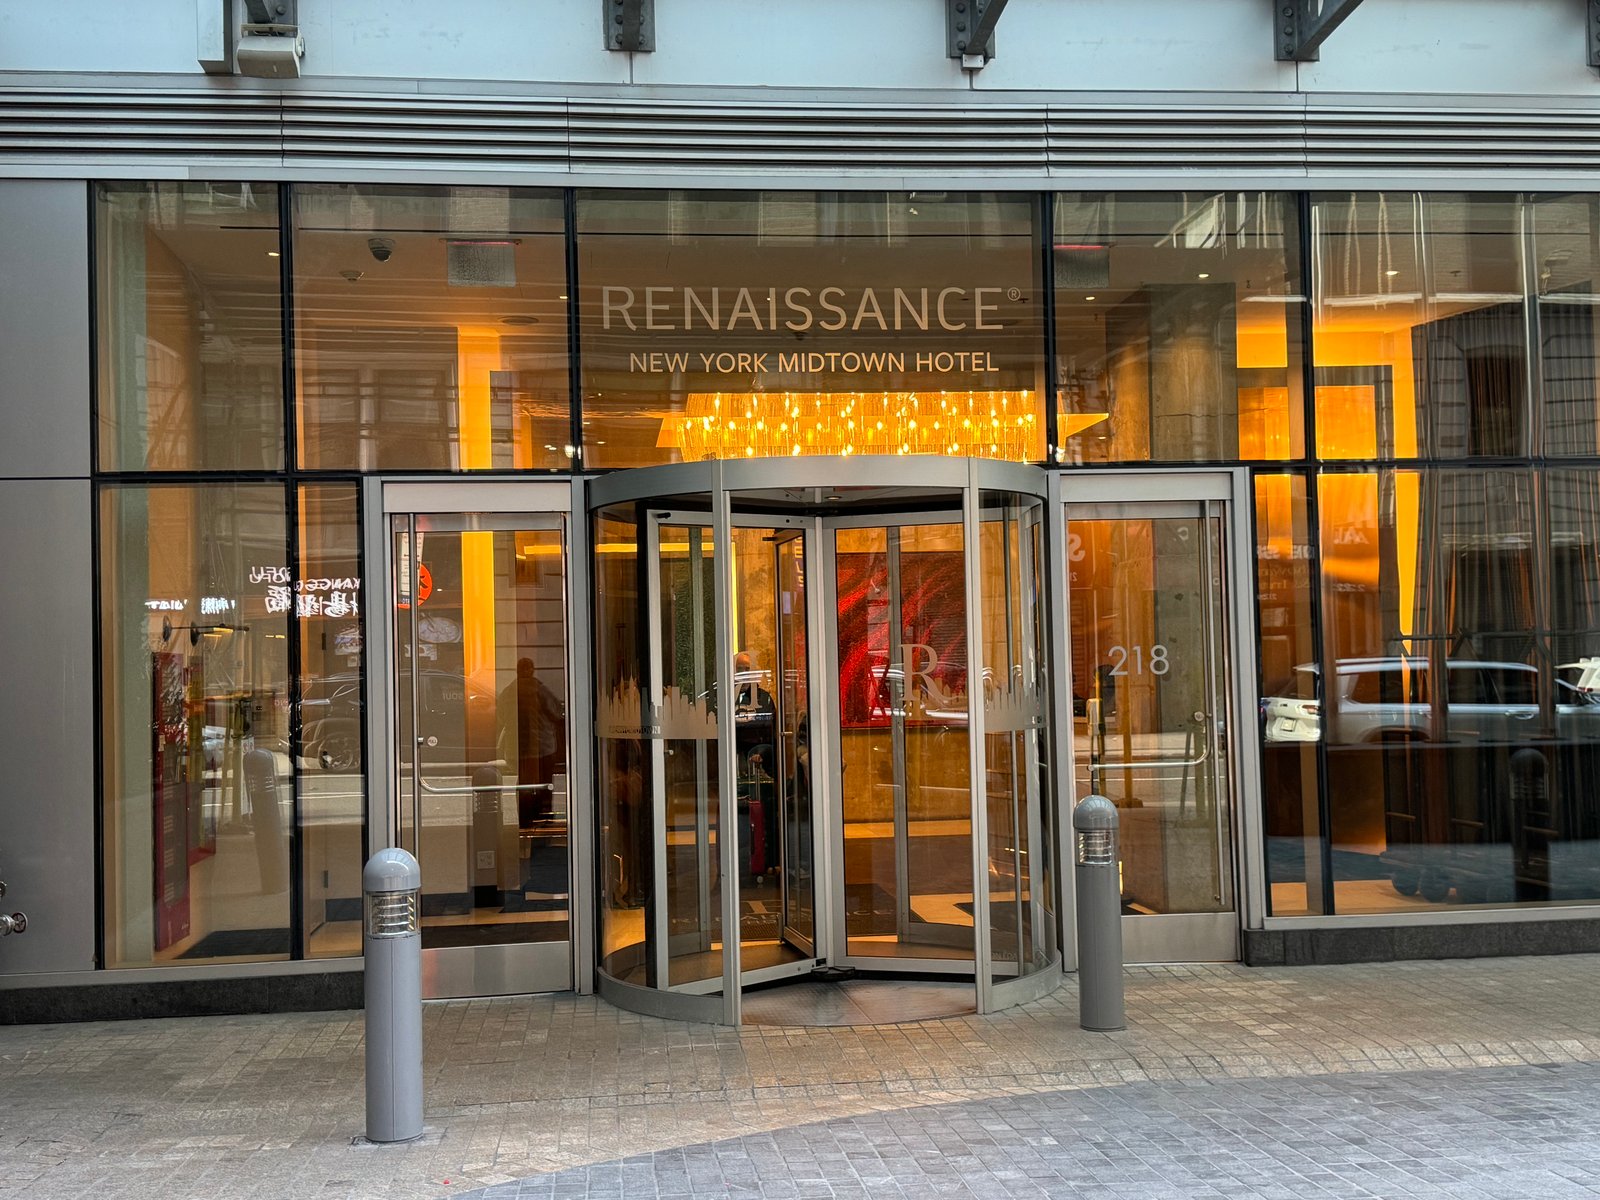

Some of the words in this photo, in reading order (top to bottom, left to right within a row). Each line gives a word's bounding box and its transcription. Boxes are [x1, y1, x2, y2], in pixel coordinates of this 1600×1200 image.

[629, 352, 689, 373] NEW
[700, 352, 769, 373] YORK
[778, 352, 905, 373] MIDTOWN
[916, 352, 1000, 373] HOTEL
[898, 643, 956, 704] R
[1108, 644, 1170, 676] 218
